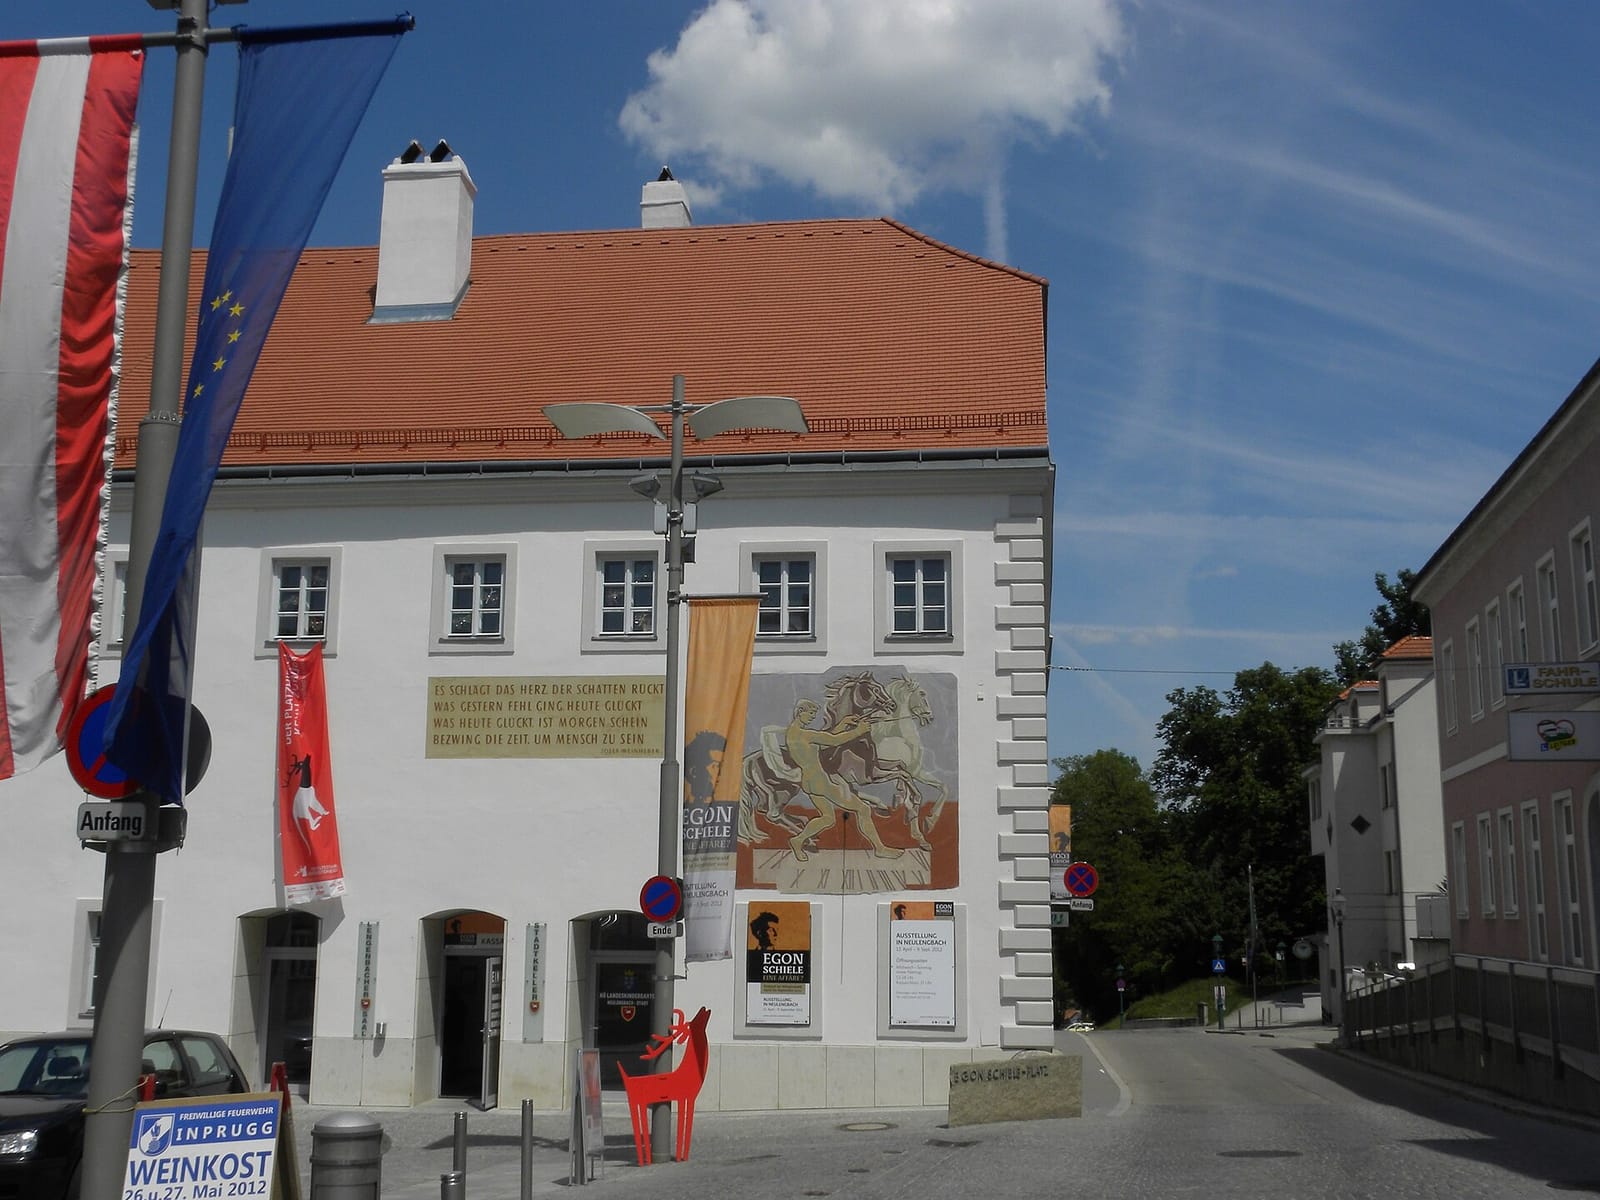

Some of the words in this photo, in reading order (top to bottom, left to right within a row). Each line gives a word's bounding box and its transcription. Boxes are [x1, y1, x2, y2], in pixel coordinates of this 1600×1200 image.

[435, 684, 446, 696] ES
[496, 684, 515, 696] DAS
[521, 684, 548, 696] HERZ
[552, 683, 573, 695] DER
[576, 683, 626, 695] SCHATTEN
[1533, 677, 1598, 689] SCHULE
[434, 701, 455, 713] WAS
[460, 701, 503, 712] GESTERN
[536, 701, 563, 712] GING
[567, 700, 600, 711] HEUTE
[433, 717, 455, 729] WAS
[459, 717, 492, 729] HEUTE
[538, 717, 553, 728] IST
[559, 716, 605, 728] MORGEN
[610, 716, 648, 728] SCHEIN
[433, 734, 481, 745] BEZWING
[485, 734, 502, 745] DIE
[534, 734, 551, 745] UM
[555, 733, 598, 745] MENSCH
[602, 733, 616, 744] ZU
[620, 733, 644, 745] SEIN
[80, 810, 142, 836] Anfang
[1071, 901, 1093, 909] Anfang
[652, 926, 672, 935] Ende
[531, 922, 540, 1000] STADTKELLER
[763, 952, 804, 966] EGON
[762, 965, 804, 975] SCHIELE
[179, 1109, 226, 1121] FREIWILLIGE
[227, 1106, 274, 1118] FEUERWEHR
[176, 1121, 273, 1141] INPRUGG
[130, 1150, 273, 1186] WEINKOST
[193, 1183, 223, 1199] Mai
[228, 1180, 267, 1197] 2012
